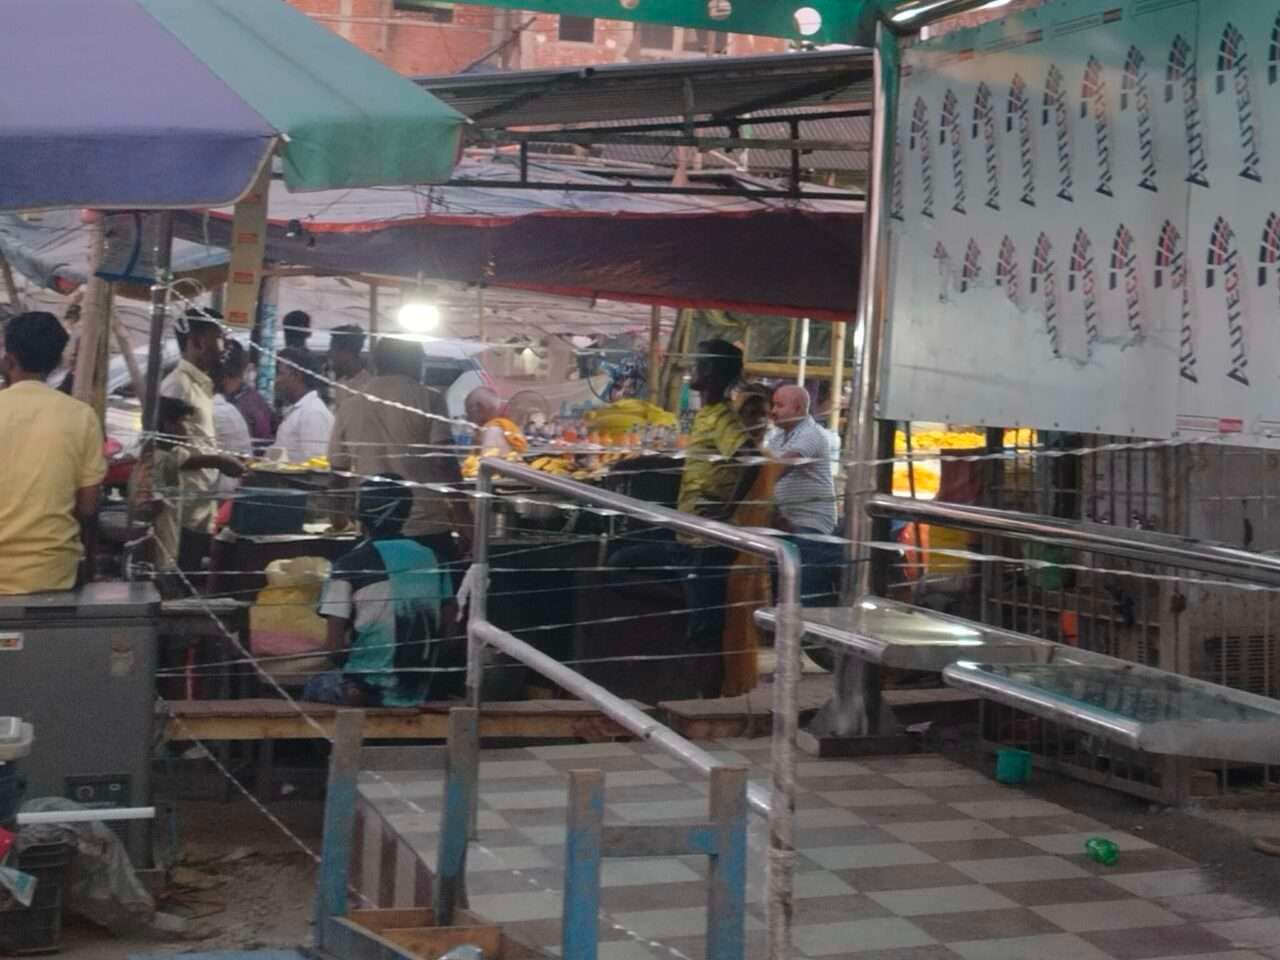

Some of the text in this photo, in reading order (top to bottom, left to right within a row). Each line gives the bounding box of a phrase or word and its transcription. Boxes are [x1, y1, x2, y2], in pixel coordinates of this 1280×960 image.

[1135, 71, 1159, 194] ALUTECH
[1232, 52, 1263, 183] ALUTECH
[1223, 248, 1251, 387] ALUTECH
